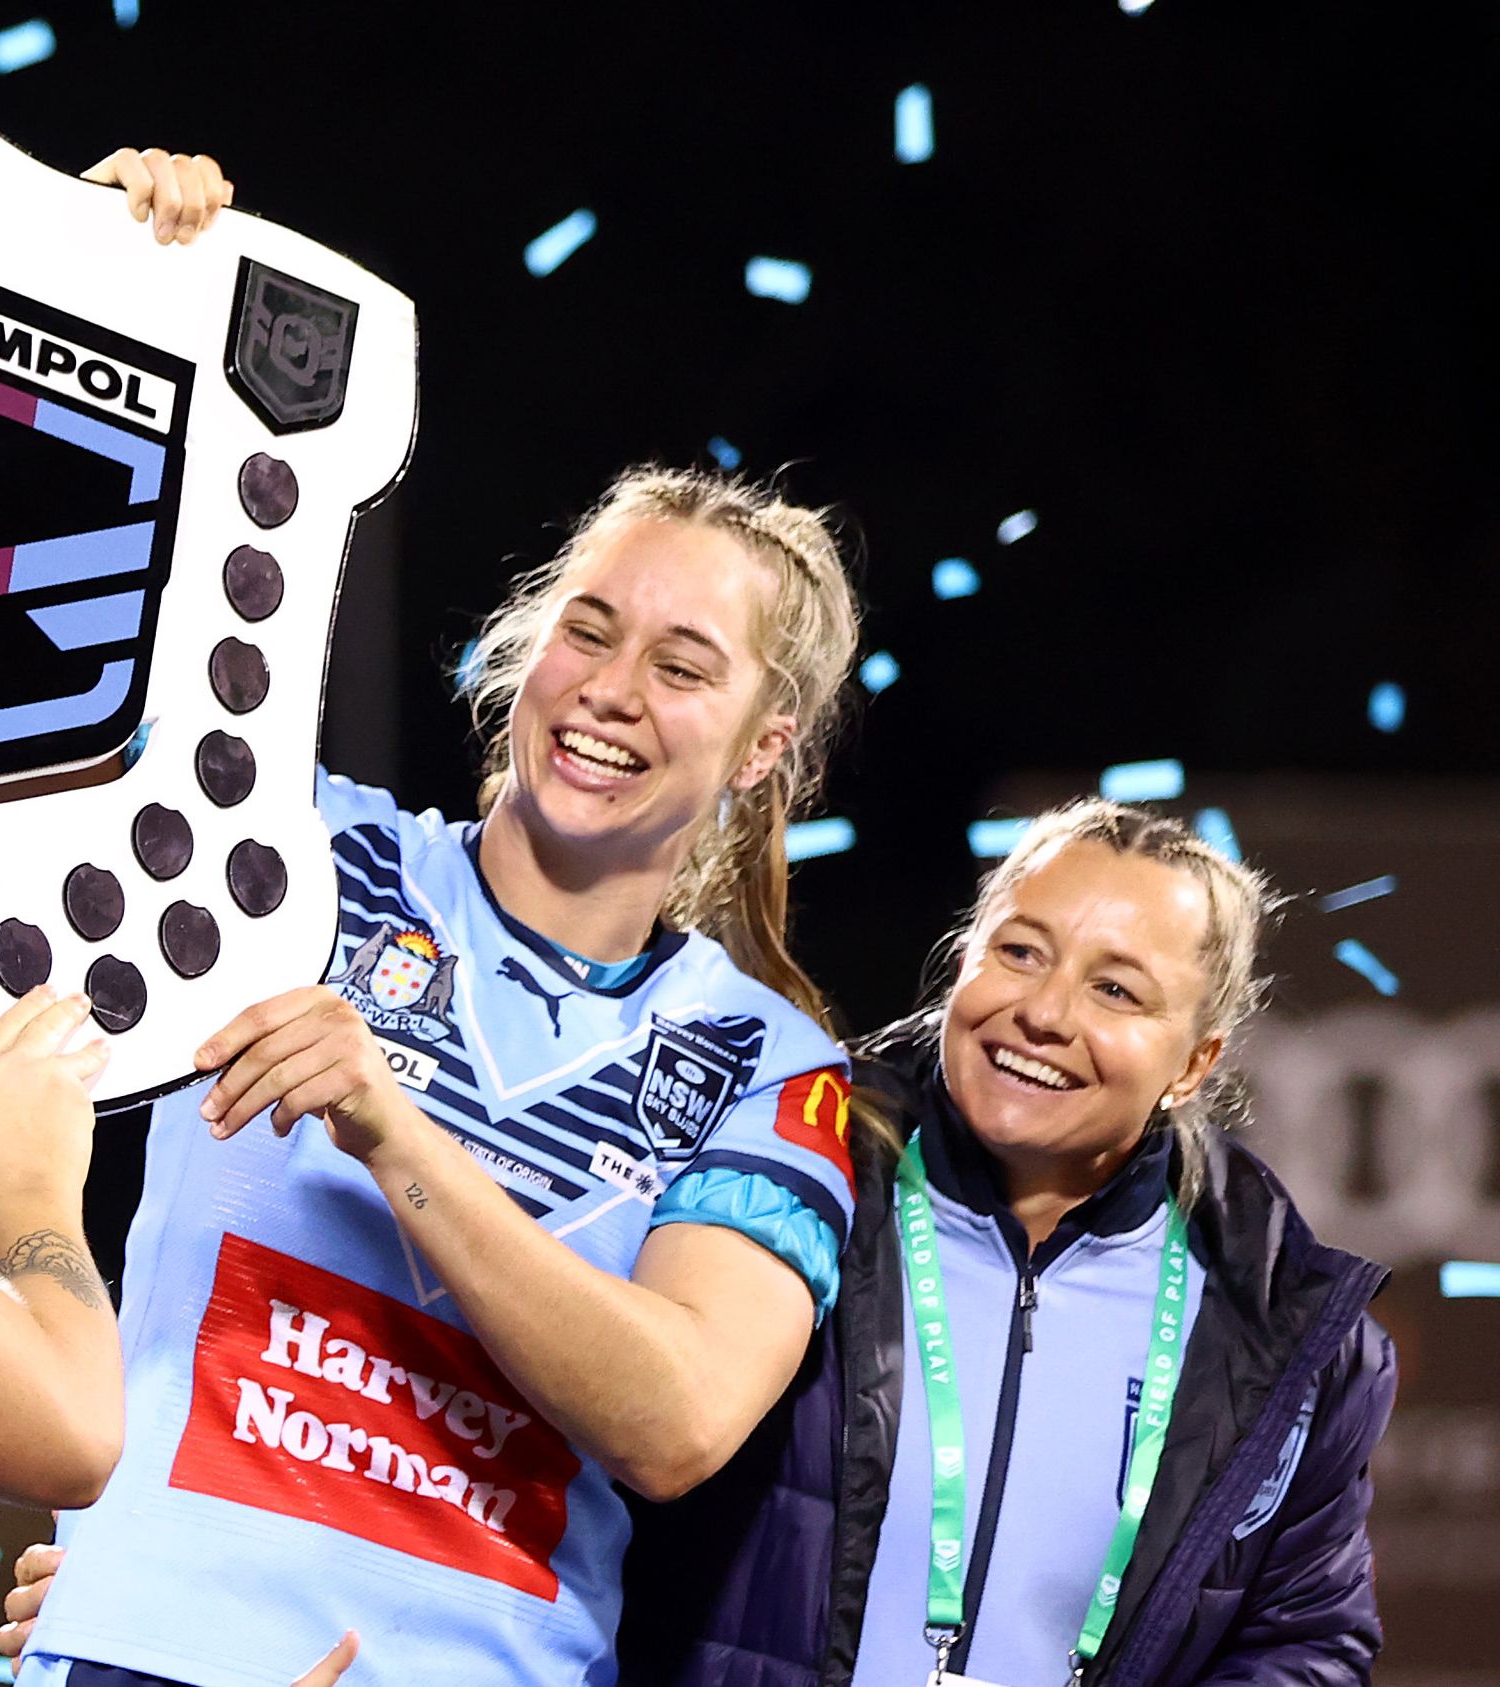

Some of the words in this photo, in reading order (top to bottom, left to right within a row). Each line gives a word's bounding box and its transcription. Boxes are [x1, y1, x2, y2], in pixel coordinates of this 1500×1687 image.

[380, 1047, 423, 1082] OL
[645, 1092, 670, 1115] SKY
[648, 1067, 714, 1123] NSW
[601, 1153, 635, 1179] THE
[404, 1182, 428, 1210] 126
[906, 1191, 933, 1265] FIELD
[917, 1276, 940, 1309] OF
[1164, 1240, 1184, 1302] PLAY
[924, 1320, 950, 1384] PLAY
[1159, 1310, 1178, 1342] OF
[260, 1298, 531, 1459] Harvey
[1146, 1353, 1172, 1428] FIELD
[233, 1377, 517, 1533] Norman
